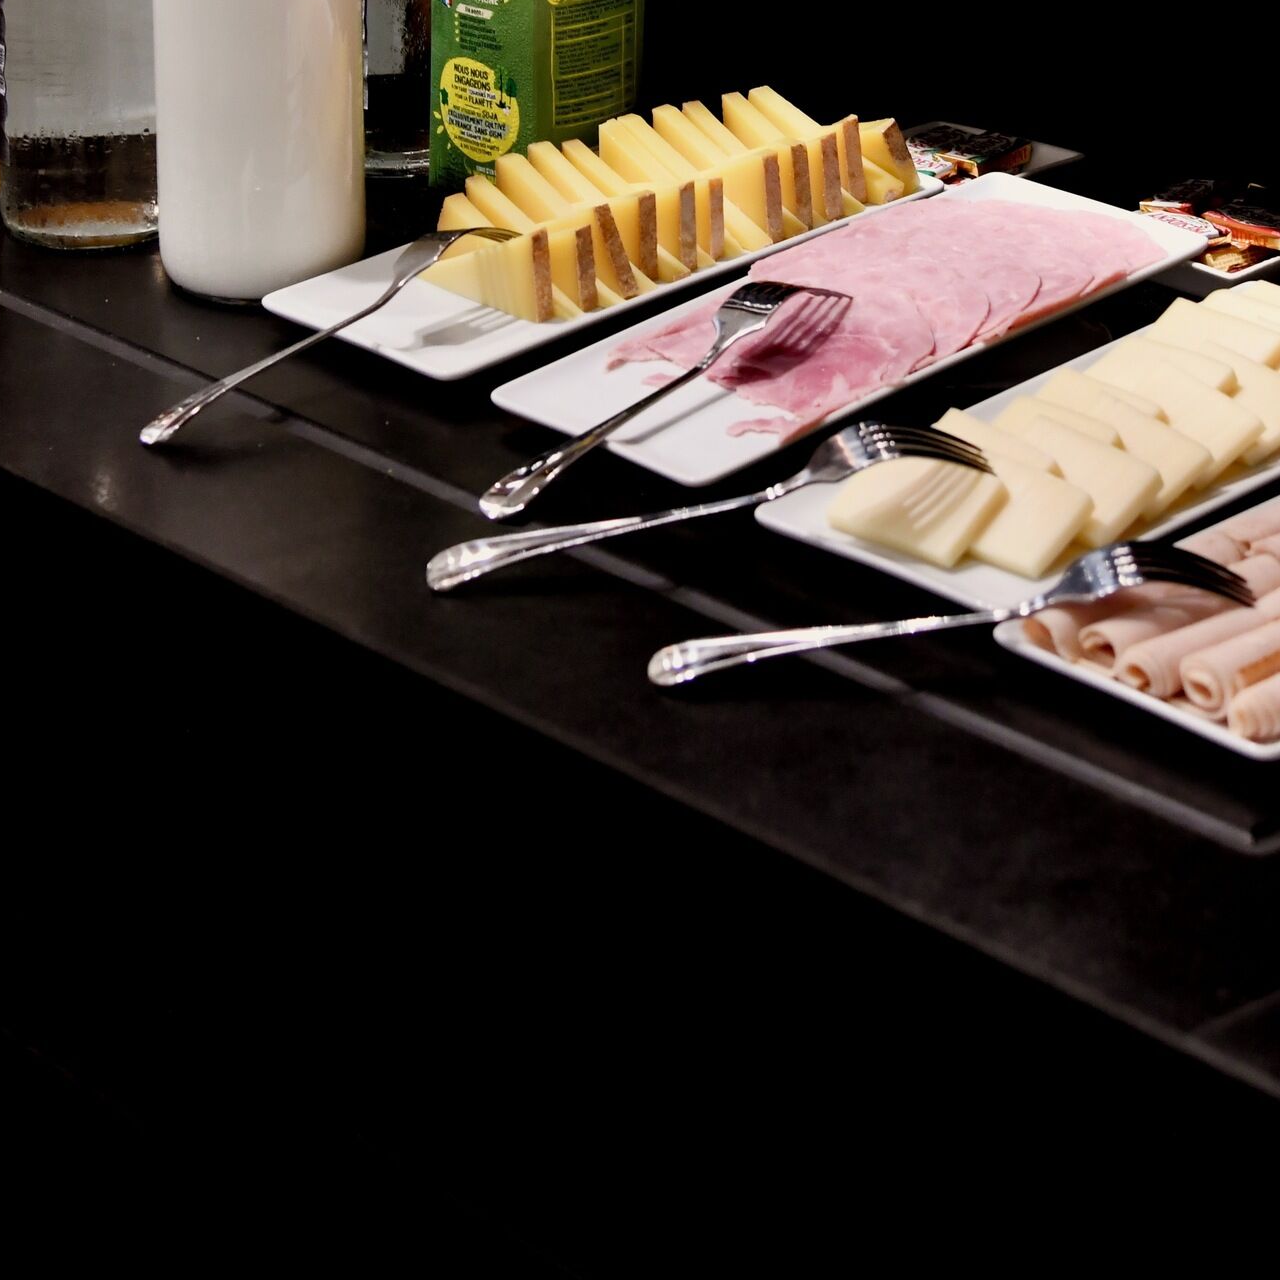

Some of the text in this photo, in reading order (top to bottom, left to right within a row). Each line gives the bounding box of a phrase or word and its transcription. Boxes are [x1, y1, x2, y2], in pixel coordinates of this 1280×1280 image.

[454, 63, 489, 81] NOUS NOUS
[455, 73, 491, 92] ENGAGEONS
[468, 95, 493, 109] PLANÈTE
[482, 109, 498, 122] SOJA
[475, 126, 488, 136] SANS
